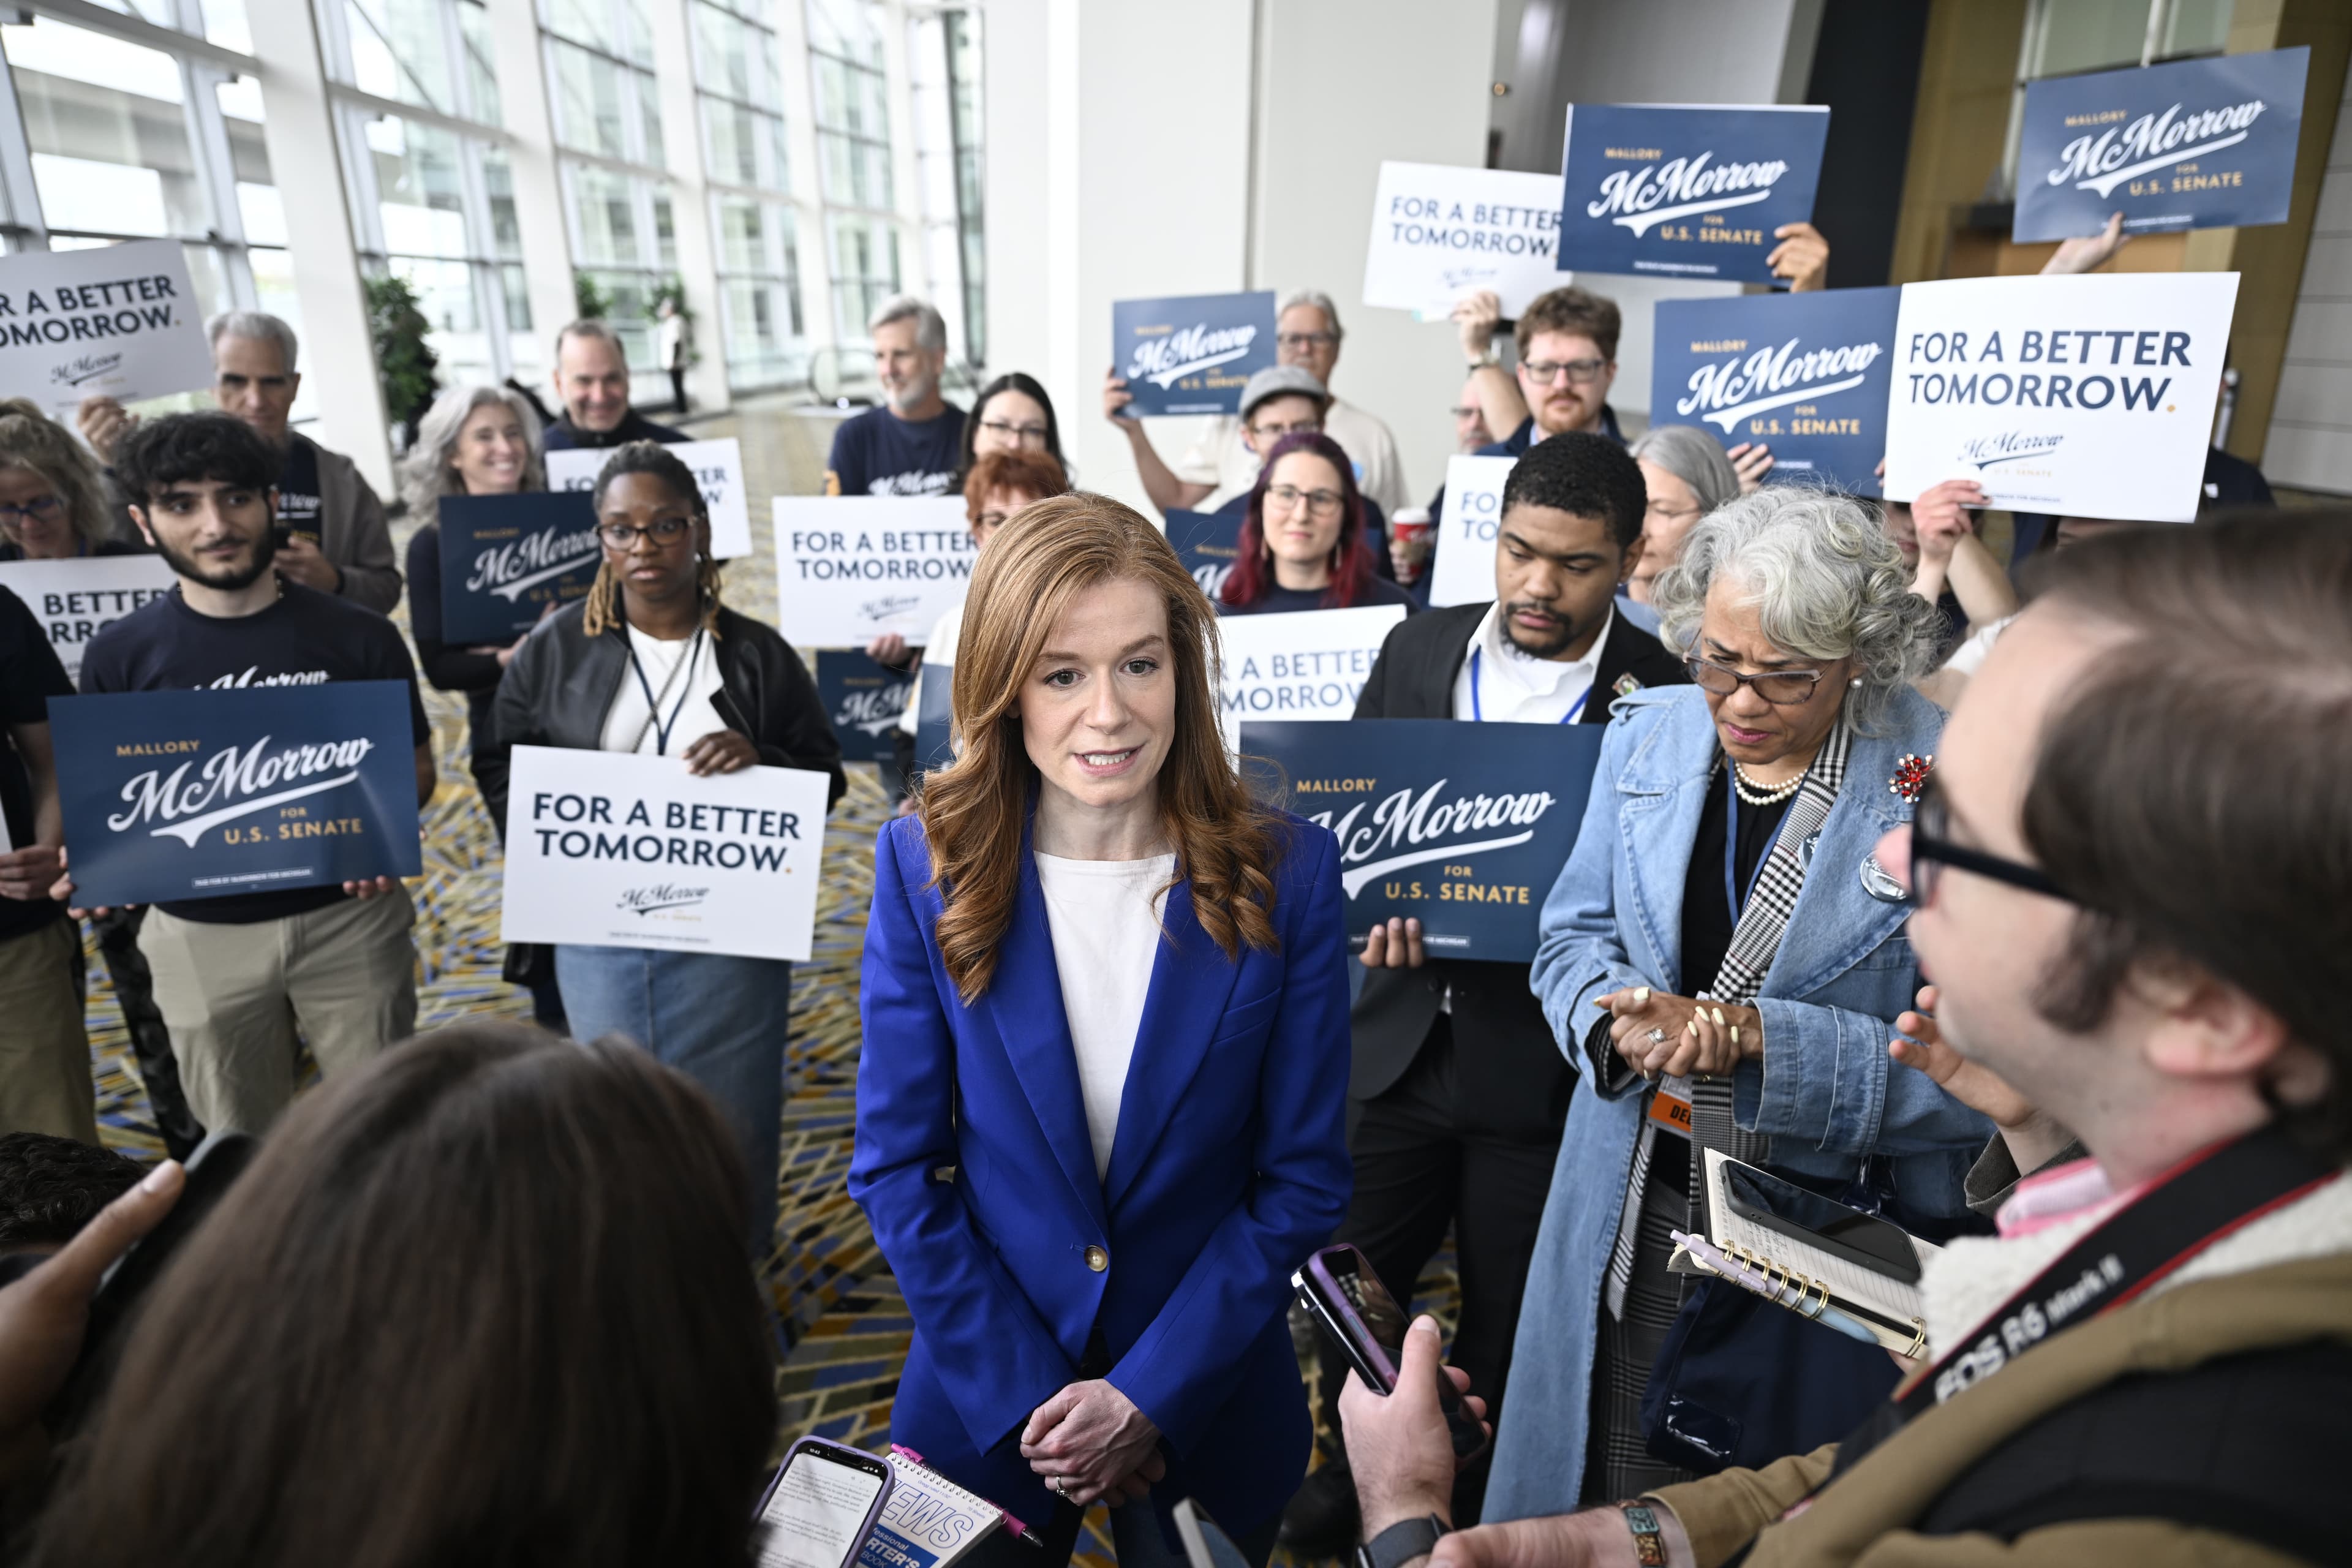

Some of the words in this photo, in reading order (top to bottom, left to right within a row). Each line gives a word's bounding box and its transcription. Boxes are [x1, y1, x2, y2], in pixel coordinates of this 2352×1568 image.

[2065, 110, 2128, 127] MALLORY
[1604, 147, 1663, 160] MALLORY
[2047, 100, 2267, 186] McMorrow
[1588, 150, 1789, 218] McMorrow
[2130, 181, 2165, 196] U.S.
[2172, 172, 2242, 192] SENATE
[1391, 197, 1439, 219] FOR
[1449, 203, 1463, 221] A
[1660, 226, 1694, 241] U.S.
[1699, 227, 1763, 245] SENATE
[28, 289, 50, 314] A
[56, 274, 178, 312] BETTER
[0, 304, 181, 347] MORROW.
[1691, 339, 1747, 353] MALLORY
[1910, 331, 1968, 364] FOR
[1978, 330, 2004, 363] A
[2019, 330, 2193, 367] BETTER
[1676, 337, 1884, 416] McMorrow
[1909, 373, 2176, 412] TOMORROW.
[1795, 405, 1817, 416] FOR
[1751, 420, 1785, 435] U.S.
[1792, 419, 1861, 435] SENATE
[793, 532, 845, 552] FOR
[857, 531, 872, 551] A
[1241, 657, 1260, 680] A
[116, 740, 200, 757] MALLORY
[107, 735, 375, 832] McMorrow
[1296, 778, 1377, 793] MALLORY
[281, 807, 307, 819] FOR
[533, 793, 612, 824] FOR
[627, 799, 651, 827] A
[666, 801, 801, 839] BETTER
[224, 827, 270, 844] U.S.
[279, 818, 363, 840] SENATE
[535, 828, 792, 873] TOMORROW.
[1444, 865, 1472, 877] FOR
[1385, 882, 1429, 899] U.S.
[1439, 883, 1530, 905] SENATE
[873, 1528, 909, 1551] essional
[866, 1537, 920, 1568] RTER'S
